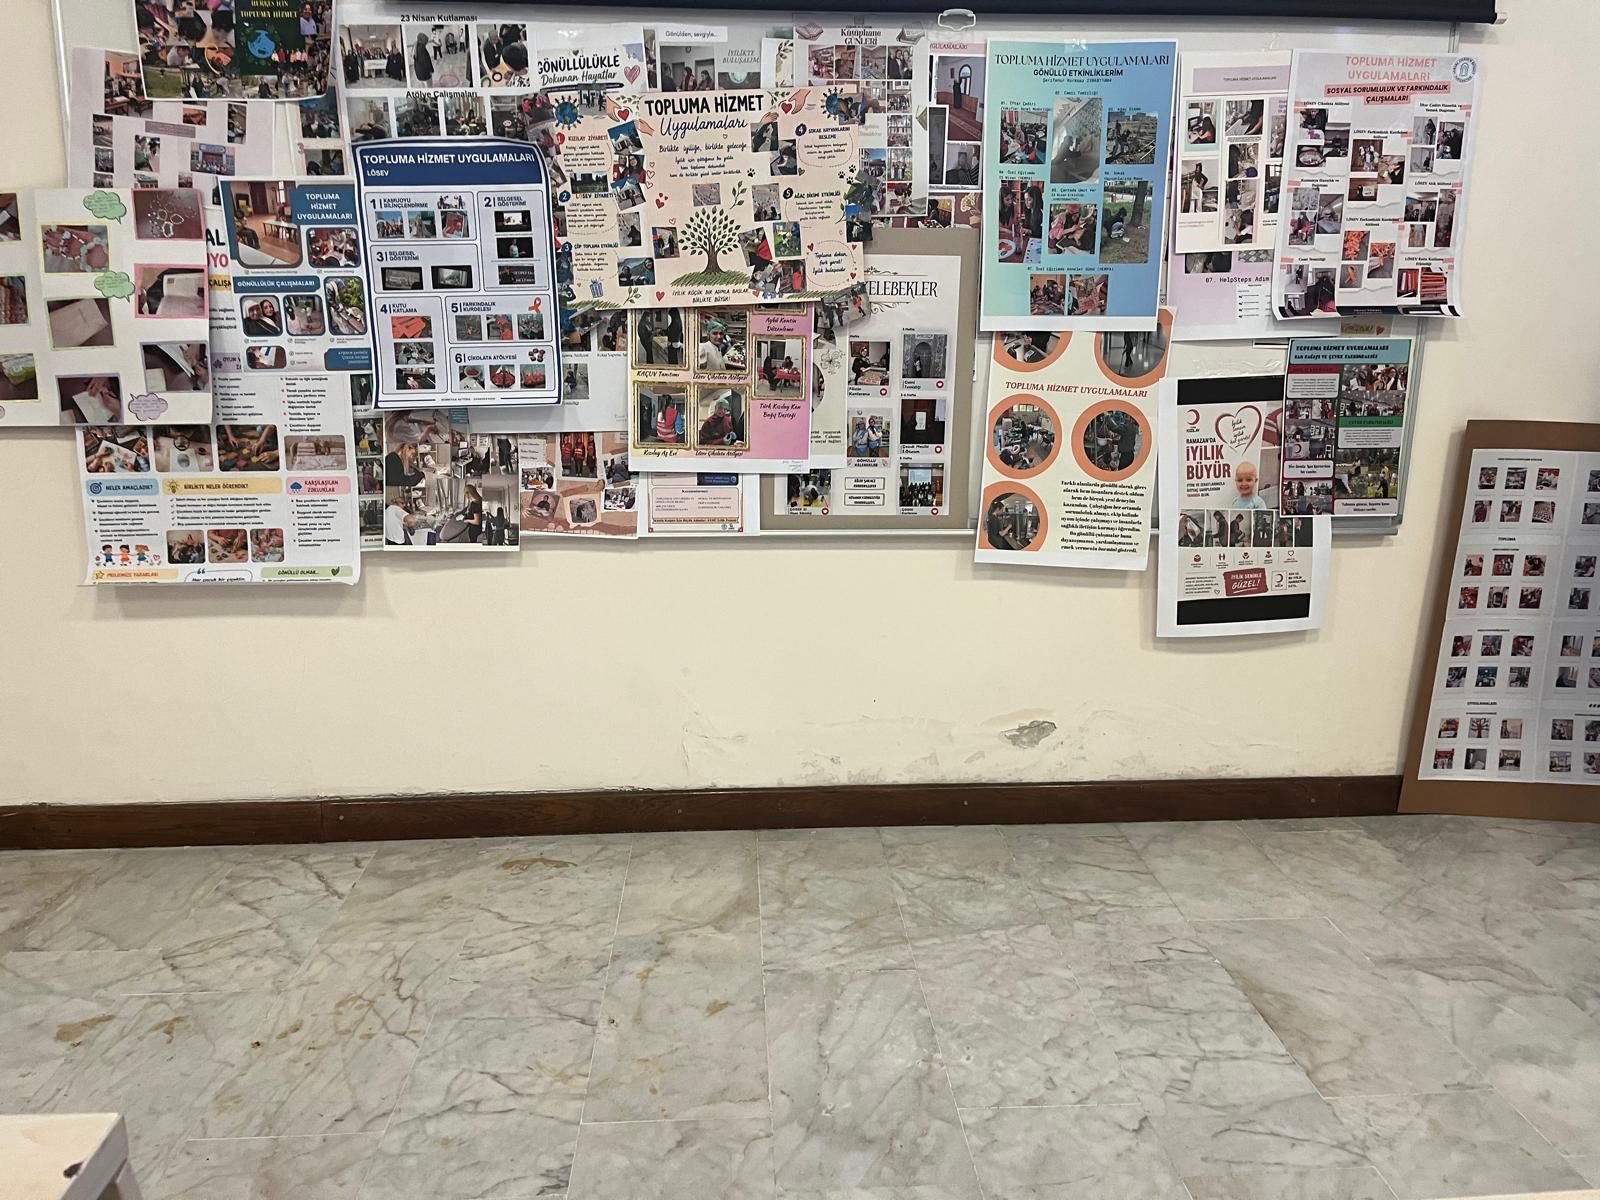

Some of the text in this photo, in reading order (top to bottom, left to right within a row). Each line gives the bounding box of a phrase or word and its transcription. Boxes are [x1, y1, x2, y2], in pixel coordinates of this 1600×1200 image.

[538, 54, 620, 75] GÖNÜLLÜLÜKLE
[996, 54, 1170, 66] TOPLUMA HİZMET UYGULAMALARI
[1345, 56, 1438, 67] TOPLUMA HİZMET
[541, 69, 617, 86] Dokunan Hayatlar
[1348, 70, 1430, 81] UYGULAMALARI
[406, 90, 478, 99] Atölye Çalışmaları
[1366, 95, 1409, 104] ÇALIŞMALARI
[645, 93, 764, 116] TOPLUMA HİZMET
[660, 114, 748, 141] Uygulamaları
[659, 145, 680, 153] Birlikte
[364, 152, 534, 165] TOPLUMA HİZMET UYGULAMALARI
[305, 193, 340, 201] TOPLUMA
[484, 197, 492, 208] 2
[370, 199, 376, 210] 1
[376, 252, 384, 262] 3
[380, 304, 388, 314] 4
[451, 302, 458, 313] 5
[455, 353, 462, 364] 6
[468, 354, 492, 362] ÇİKOLATA
[1006, 382, 1148, 398] TOPLUMA HİZMET UYGULAMALARI
[1186, 461, 1231, 480] BÜYÜR
